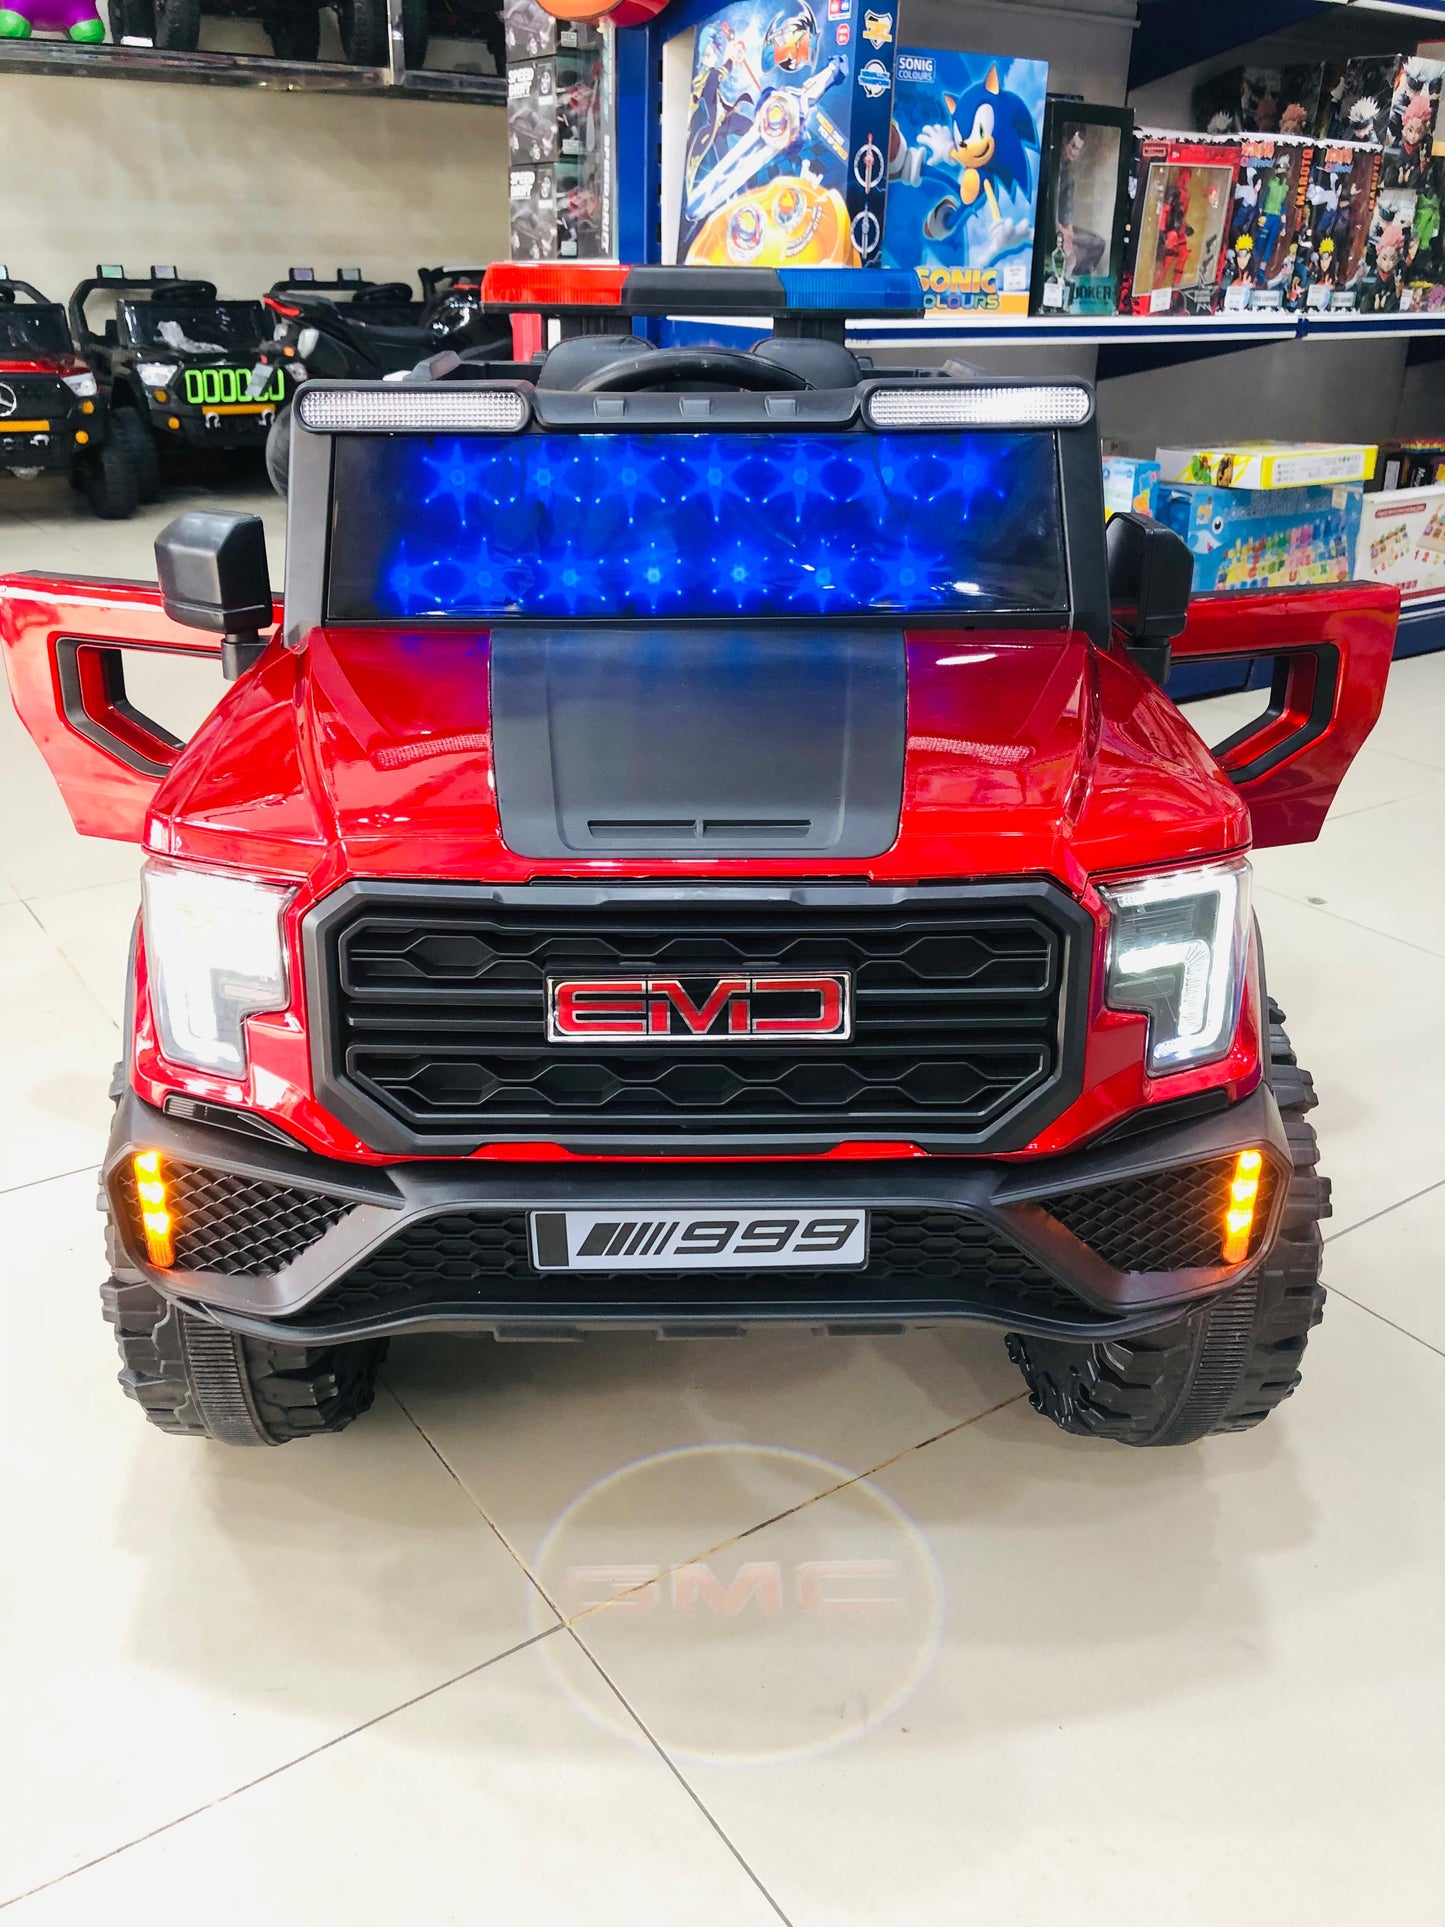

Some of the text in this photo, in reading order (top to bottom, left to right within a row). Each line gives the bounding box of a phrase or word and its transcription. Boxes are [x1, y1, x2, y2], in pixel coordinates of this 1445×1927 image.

[898, 70, 933, 81] COLOURS
[1295, 147, 1314, 206] NARUTO
[917, 268, 998, 294] SONIC
[923, 293, 999, 309] OLOURS
[673, 1218, 861, 1255] 999
[565, 1557, 906, 1617] GMC
